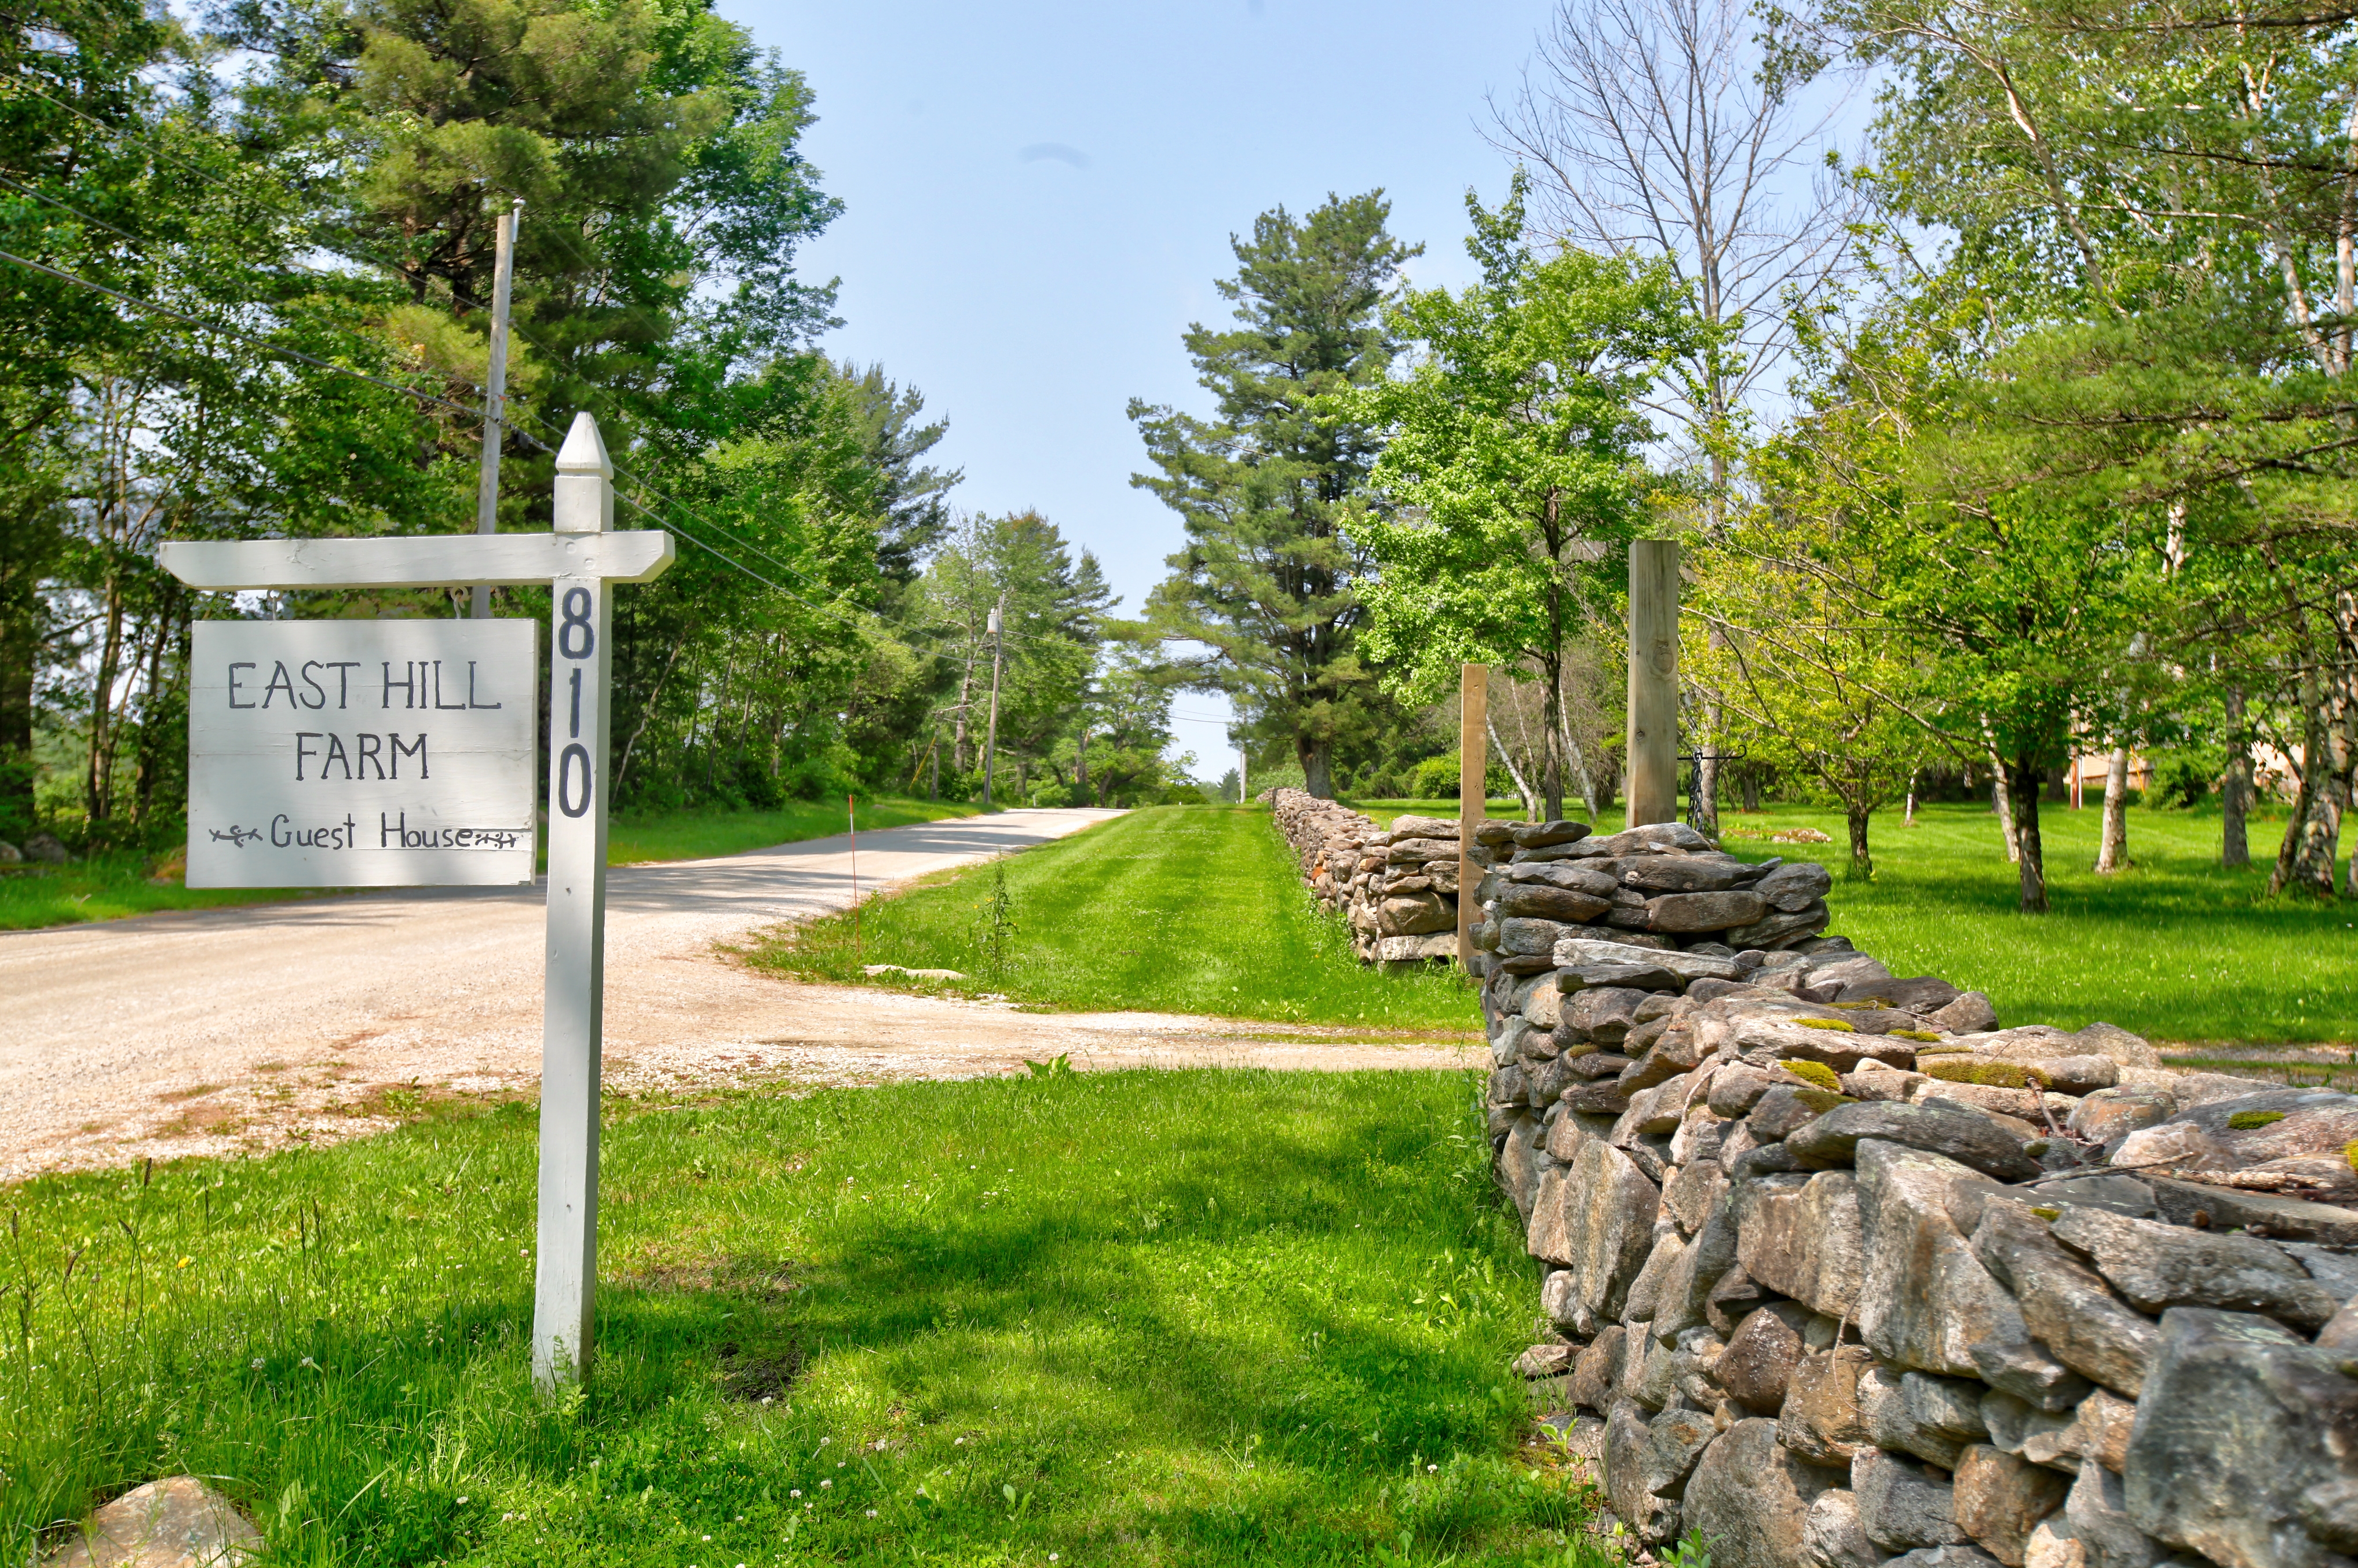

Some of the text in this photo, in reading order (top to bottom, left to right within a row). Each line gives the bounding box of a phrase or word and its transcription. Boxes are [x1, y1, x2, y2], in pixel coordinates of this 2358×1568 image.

[228, 660, 502, 710] EAST HILL
[558, 586, 594, 818] 810
[295, 732, 429, 781] FARM
[271, 812, 472, 850] Guest House
